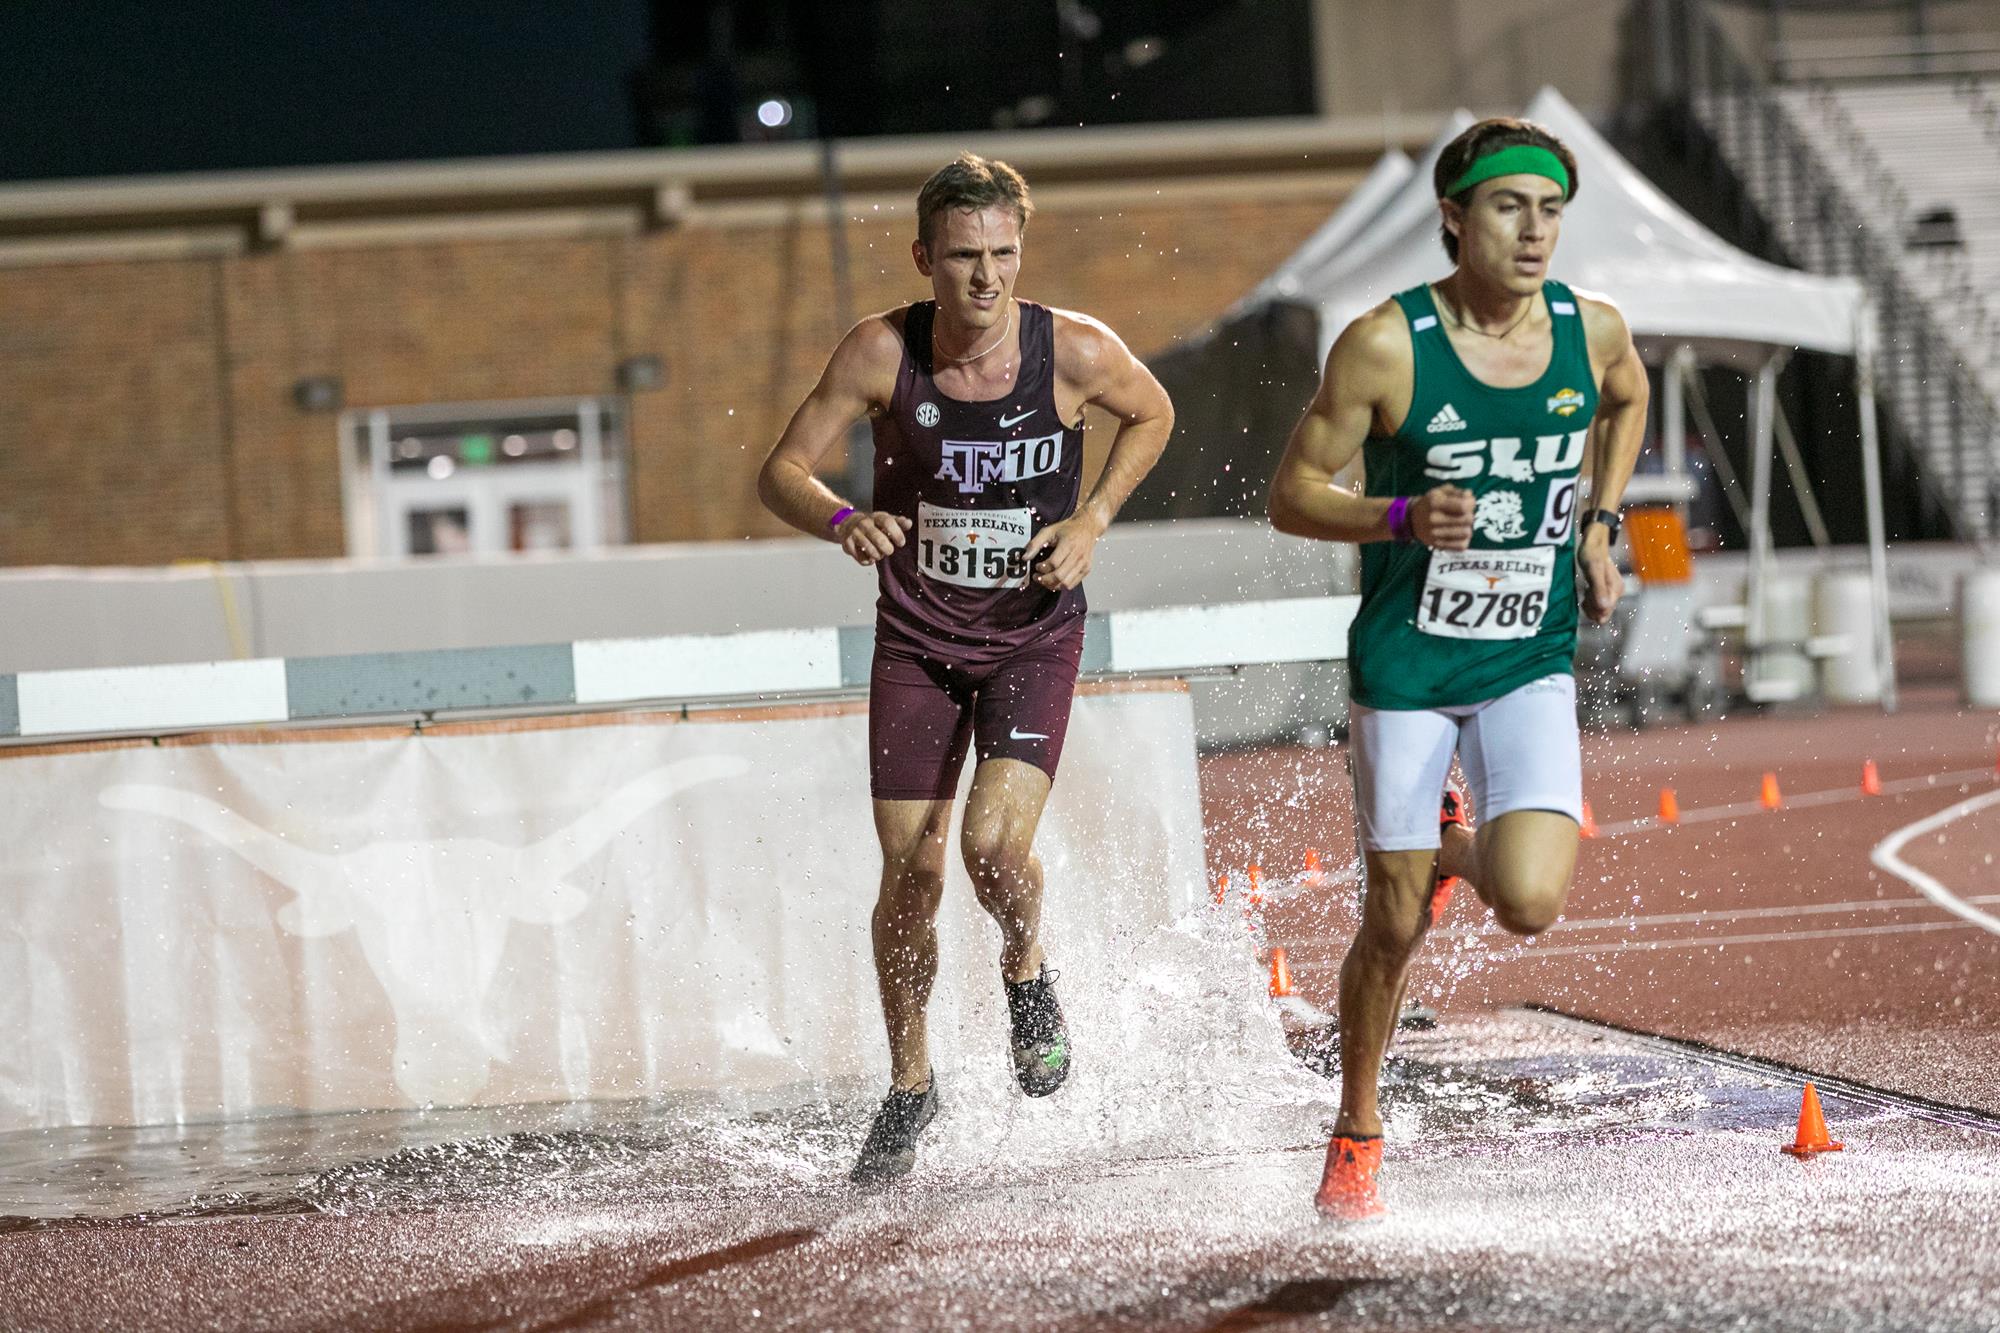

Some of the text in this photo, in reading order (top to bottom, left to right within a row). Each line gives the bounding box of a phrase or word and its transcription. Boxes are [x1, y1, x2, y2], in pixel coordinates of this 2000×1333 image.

[919, 404, 938, 425] SEC
[1426, 420, 1467, 433] adidas
[1010, 439, 1056, 478] 10
[1424, 429, 1588, 483] SLU
[1546, 484, 1575, 539] 9
[924, 518, 1025, 536] TEXAS RELAYS
[1438, 561, 1546, 576] TEXAS RELAYS
[1427, 587, 1544, 628] 12786
